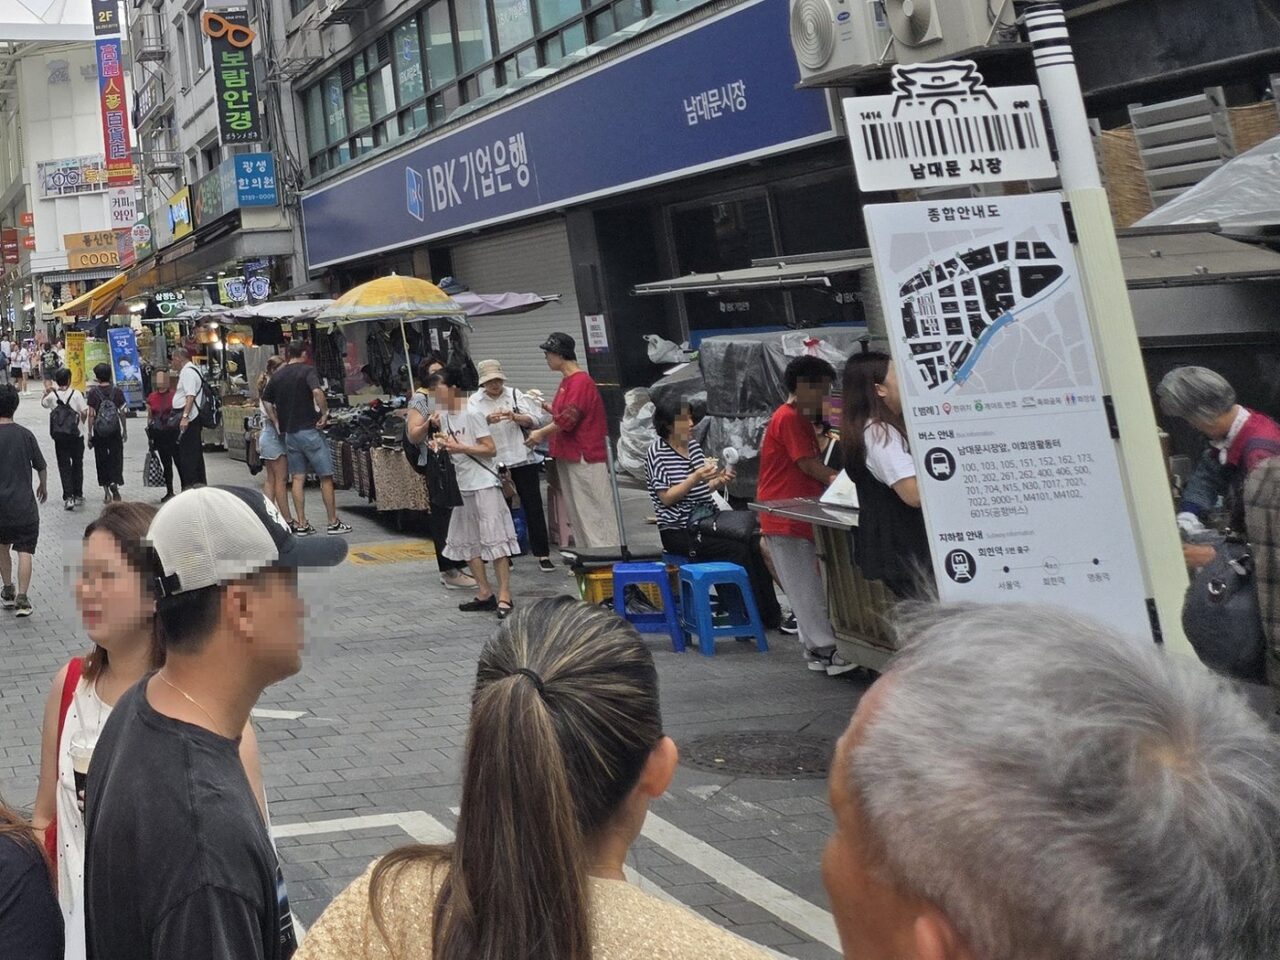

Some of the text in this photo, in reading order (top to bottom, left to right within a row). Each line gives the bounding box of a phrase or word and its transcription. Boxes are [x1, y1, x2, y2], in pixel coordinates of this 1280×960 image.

[98, 10, 113, 23] 2F
[220, 50, 253, 131] 보람안경
[683, 79, 749, 128] 남대문시장
[860, 111, 882, 121] 1414
[909, 157, 1003, 180] 남대문 시장
[238, 176, 275, 190] 한의원
[927, 204, 1001, 222] 종합안내도
[918, 431, 936, 441] 버스
[937, 429, 955, 440] 안내
[939, 532, 964, 543] 지하철
[966, 530, 984, 541] 안내
